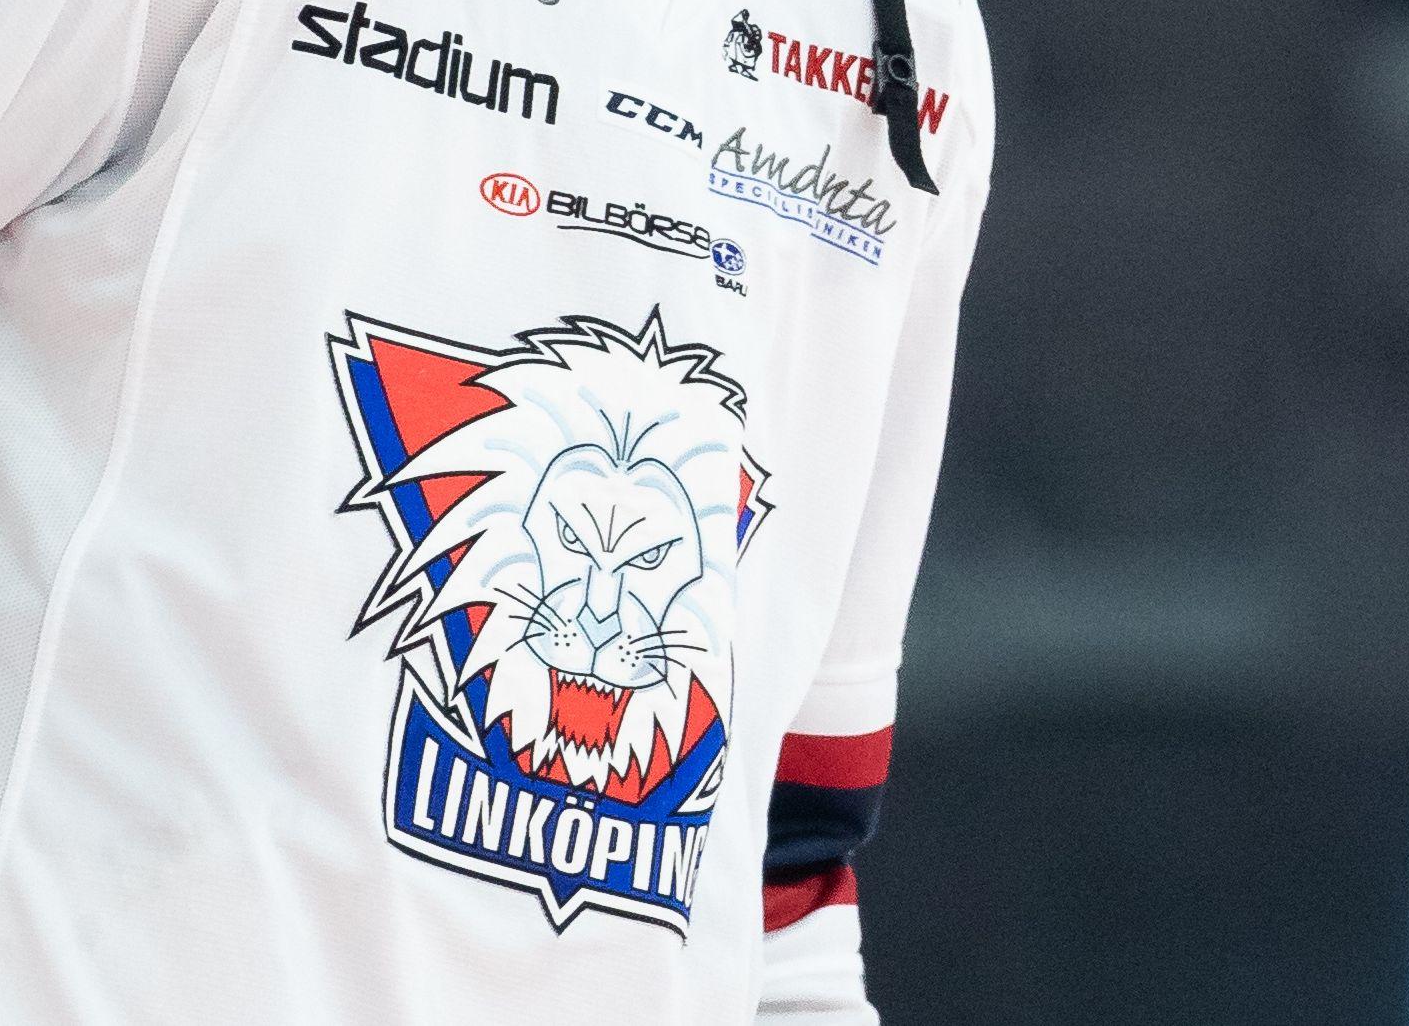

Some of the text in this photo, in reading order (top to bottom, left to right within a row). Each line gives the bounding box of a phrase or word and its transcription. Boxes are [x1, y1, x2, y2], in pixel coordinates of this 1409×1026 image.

[291, 1, 560, 125] stadium
[605, 90, 704, 150] CCM
[491, 179, 532, 213] KIA
